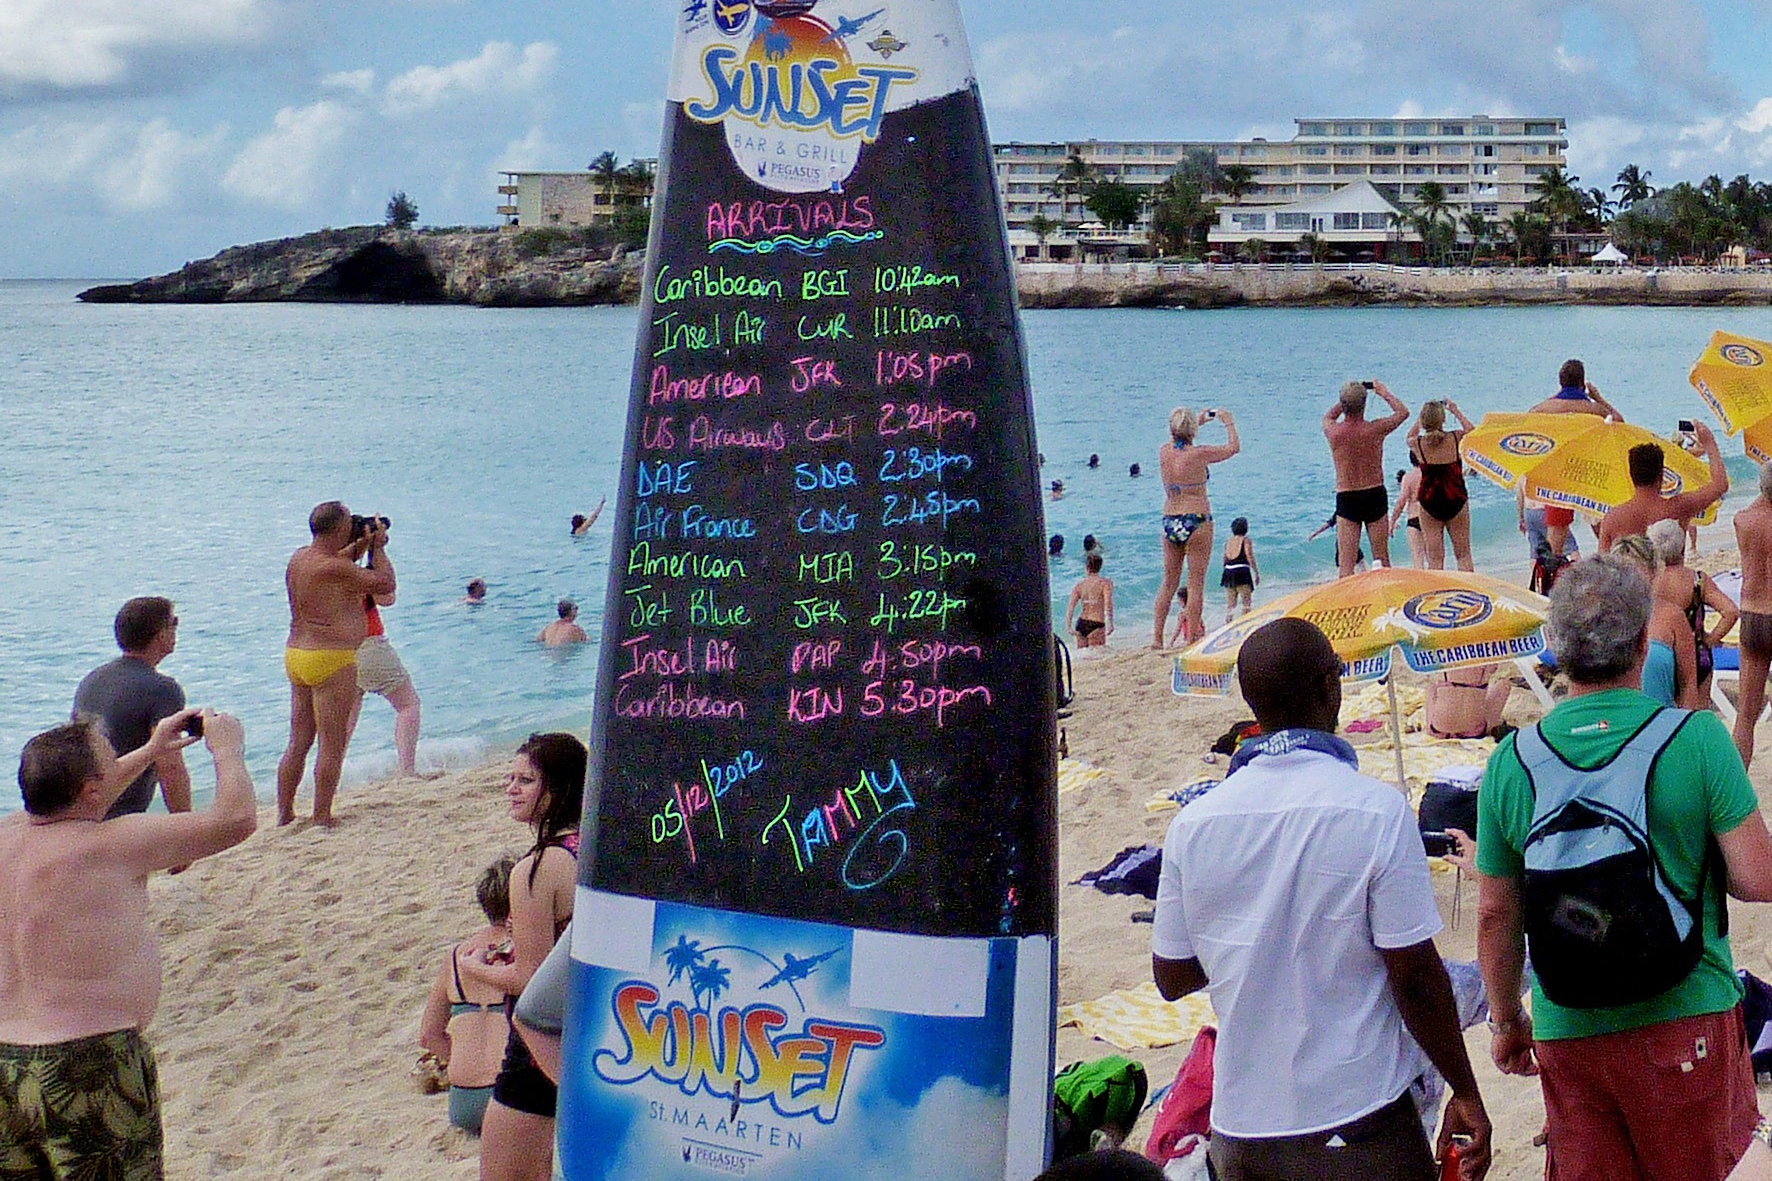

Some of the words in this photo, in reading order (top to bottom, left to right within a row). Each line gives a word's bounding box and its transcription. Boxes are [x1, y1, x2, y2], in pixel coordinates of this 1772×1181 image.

[685, 45, 918, 141] SUNSET
[733, 133, 767, 153] BAR
[776, 141, 785, 155] &
[797, 143, 848, 164] GRILL
[771, 162, 820, 179] PEGASUS
[708, 195, 875, 240] ARRIVALS
[653, 264, 783, 304] Caribbean
[802, 269, 850, 300] BGI
[874, 265, 960, 296] 10:42am
[653, 312, 721, 357] Insel
[734, 310, 767, 345] Air
[797, 313, 854, 340] CUR
[874, 306, 961, 337] 11:10am
[650, 364, 761, 406] American
[643, 415, 675, 450] US
[879, 403, 977, 441] 2:24pm
[637, 460, 697, 498] DAE
[795, 462, 859, 489] SDQ
[880, 447, 973, 483] 2:30pm
[634, 497, 673, 541] Air
[682, 504, 757, 539] France
[797, 505, 860, 534] CDG
[882, 490, 981, 529] 2:45pm
[1536, 487, 1551, 500] THE
[1552, 491, 1596, 509] CARIBBEAN
[627, 540, 747, 578] American
[798, 550, 854, 584] MIA
[877, 540, 977, 582] 3:15pm
[625, 584, 669, 628] Jet
[690, 589, 752, 627] Blue
[793, 597, 848, 629] JFK
[617, 634, 694, 680] Insel
[705, 637, 738, 675] Air
[791, 639, 842, 675] PAP
[1354, 656, 1384, 674] BEER
[1413, 649, 1439, 667] THE
[1437, 640, 1508, 665] CARIBBEAN
[1508, 636, 1541, 653] BEER
[615, 683, 746, 720] Caribbean
[789, 687, 844, 722] KIN
[651, 749, 764, 864] 05/12/2012
[762, 758, 917, 890] TAMMY
[592, 979, 886, 1124] SUNSET
[695, 1147, 746, 1169] PEGASUS
